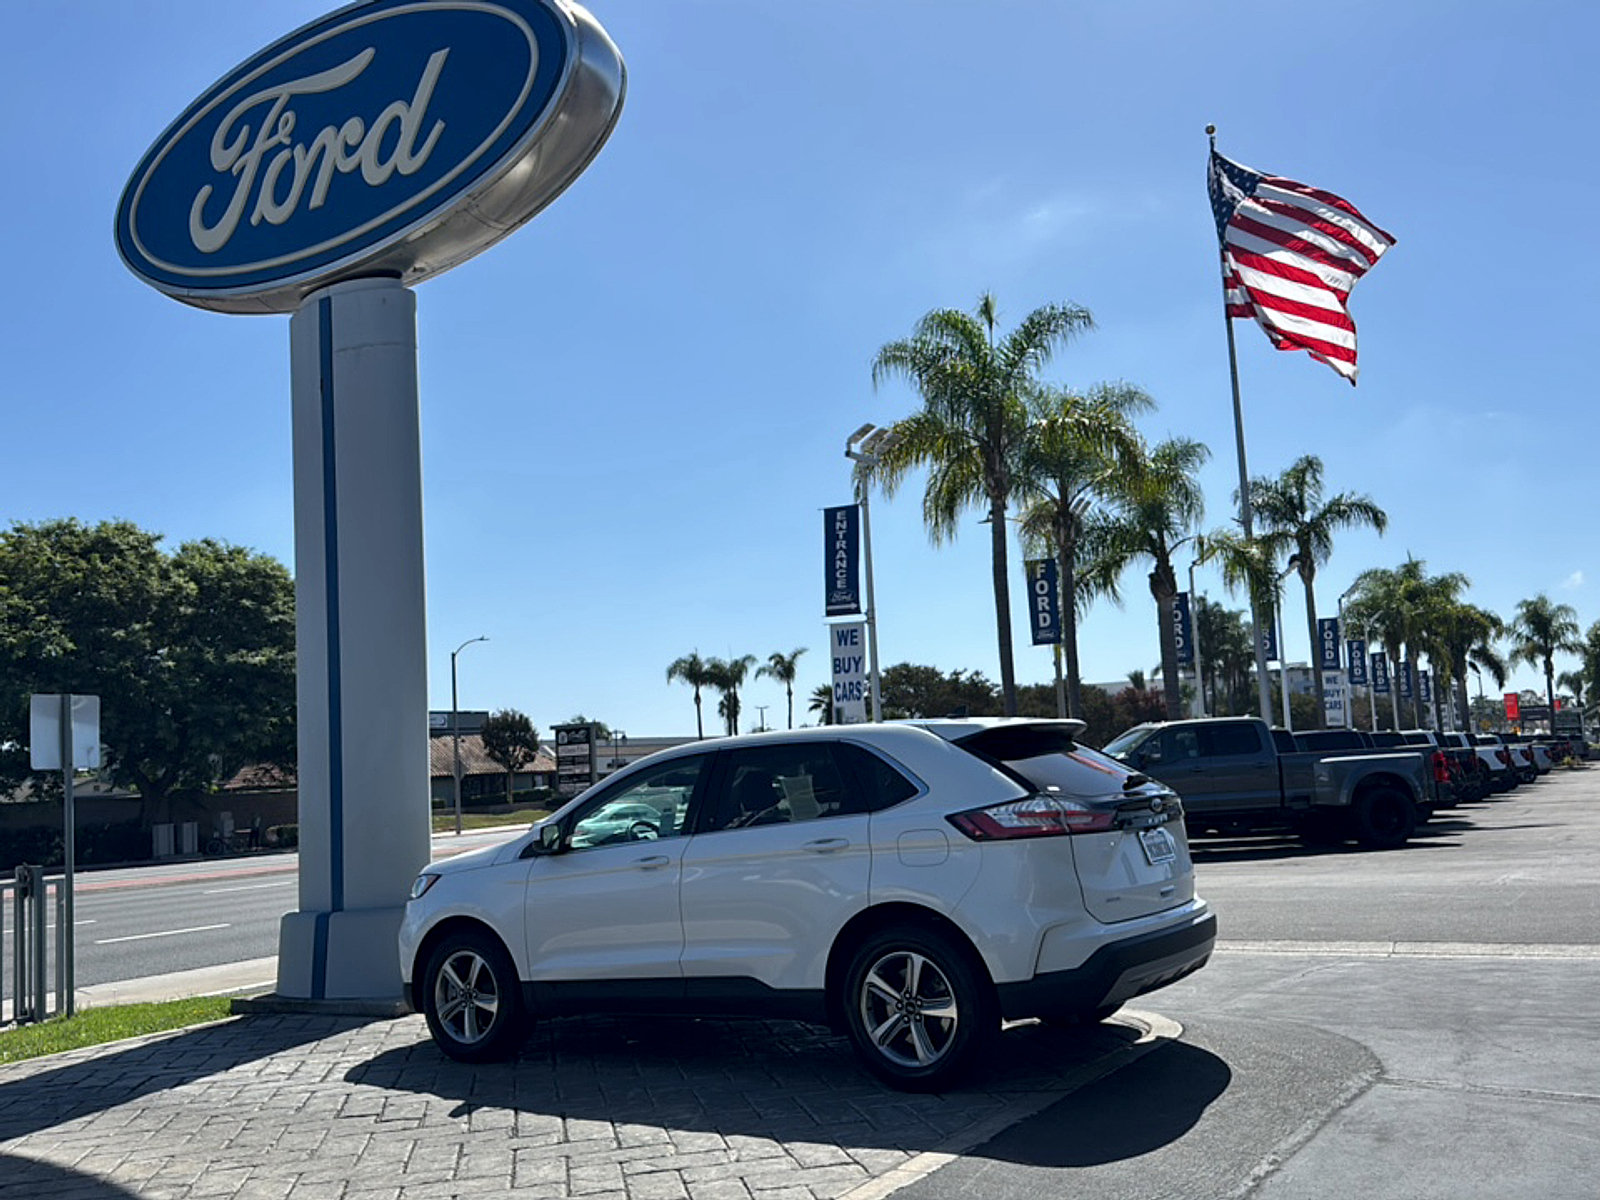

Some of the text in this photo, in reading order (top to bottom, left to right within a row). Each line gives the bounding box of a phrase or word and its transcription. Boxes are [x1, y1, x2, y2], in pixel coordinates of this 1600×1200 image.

[189, 47, 450, 253] Ford
[834, 510, 848, 589] ENTRANCE
[1035, 562, 1051, 628] FORD
[836, 628, 859, 646] WE
[1323, 621, 1334, 660] FORD
[833, 656, 862, 674] BUY
[1351, 642, 1363, 676] FORD
[1375, 654, 1385, 685] FORD
[835, 681, 862, 702] CARS
[1324, 689, 1341, 698] BUY
[1325, 676, 1338, 685] WE
[1325, 700, 1342, 710] CARS
